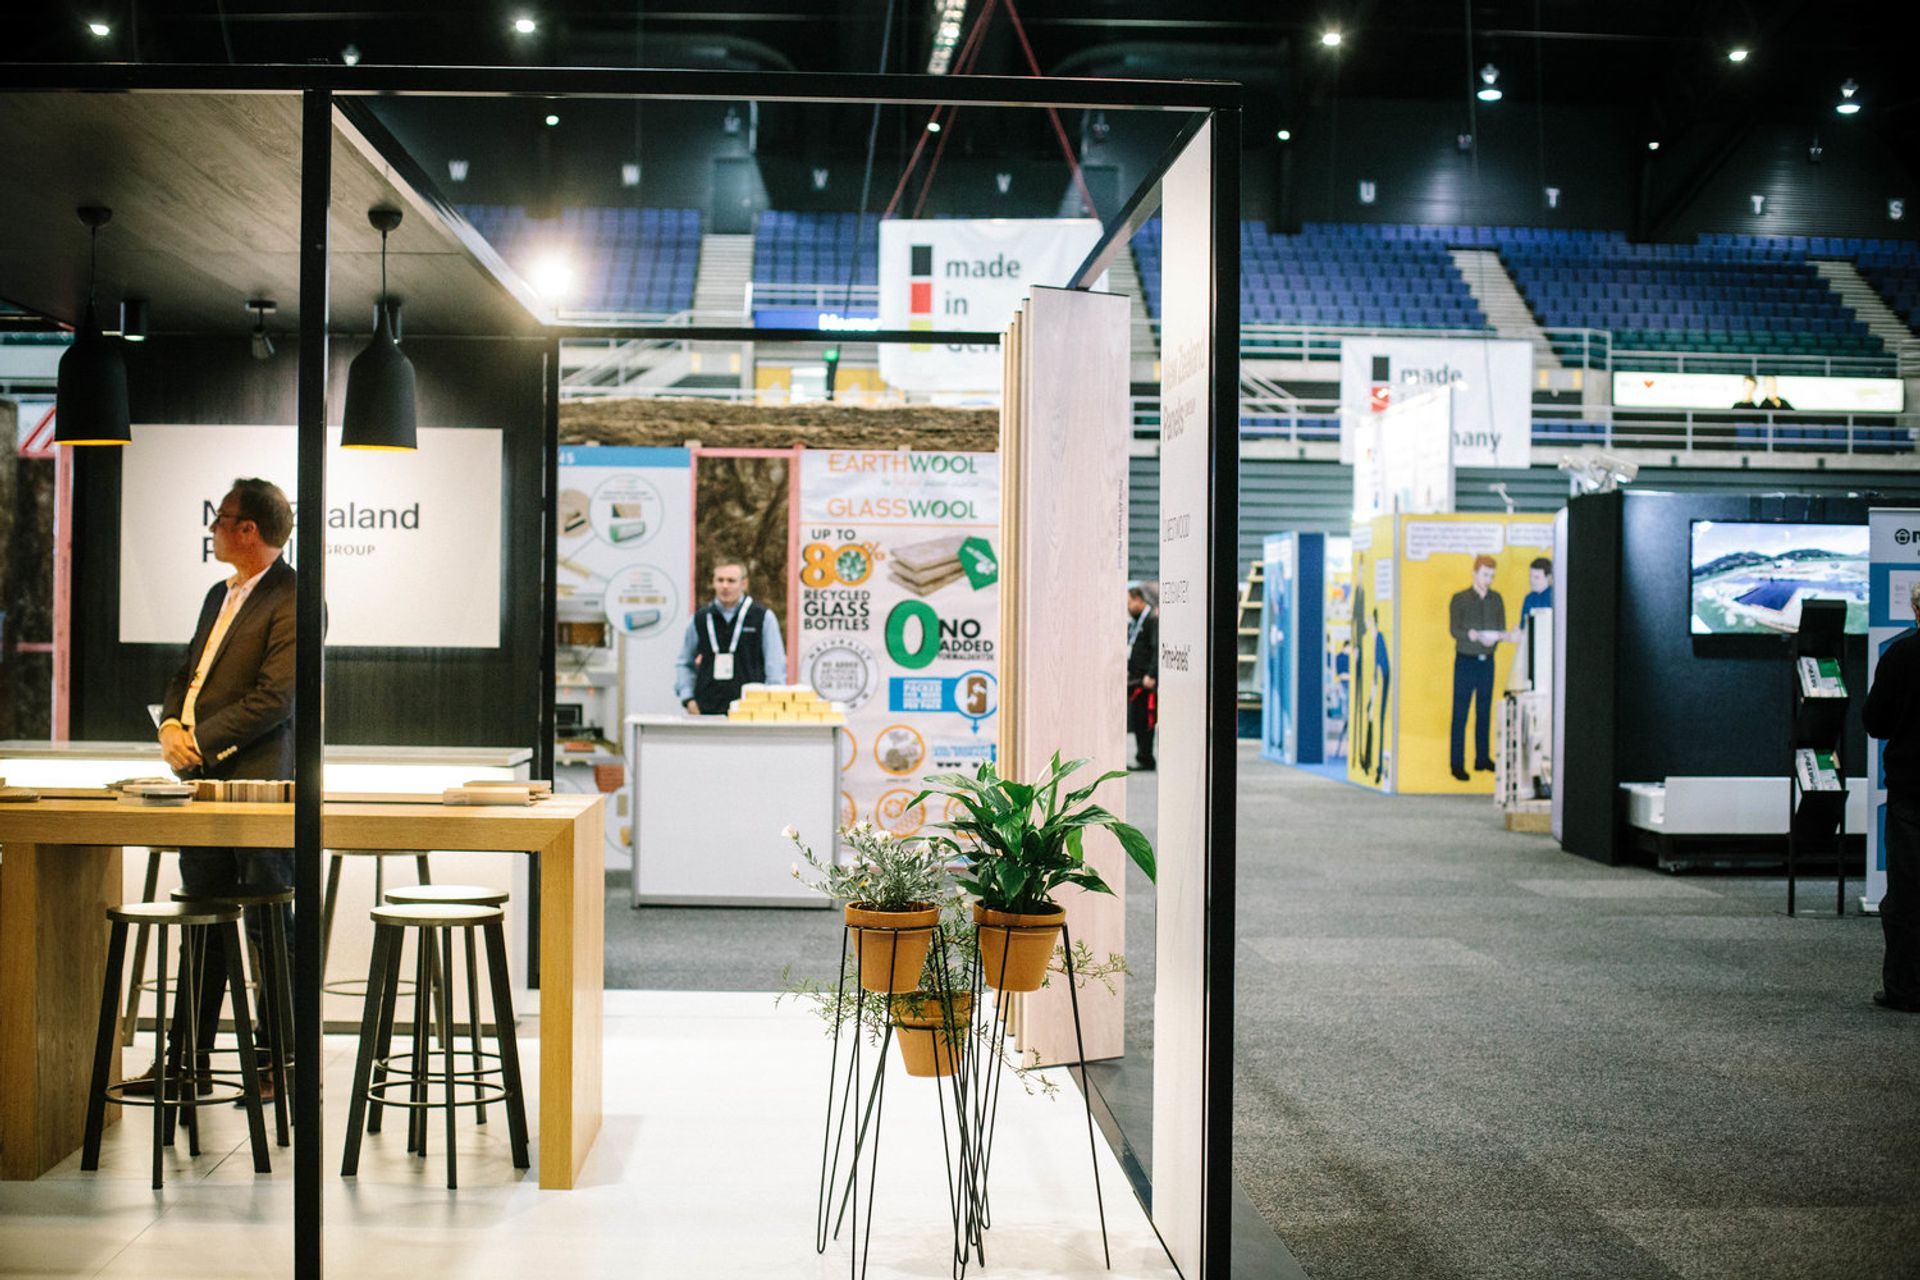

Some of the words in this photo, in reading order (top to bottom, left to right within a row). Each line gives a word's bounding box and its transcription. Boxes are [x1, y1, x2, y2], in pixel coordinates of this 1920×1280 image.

[448, 158, 469, 181] W
[1360, 181, 1376, 203] U
[1545, 187, 1560, 208] T
[1751, 194, 1765, 215] T
[1889, 200, 1904, 220] S
[945, 252, 1021, 278] made
[945, 294, 968, 315] in
[828, 452, 977, 474] EARTHWOOL
[827, 498, 977, 518] GLASSWOOL
[811, 529, 831, 540] UP
[837, 529, 856, 540] TO
[804, 590, 870, 600] RECYCLED
[804, 601, 870, 617] GLASS
[804, 618, 870, 631] BOTTLES
[939, 619, 981, 639] NO
[940, 640, 994, 652] ADDED
